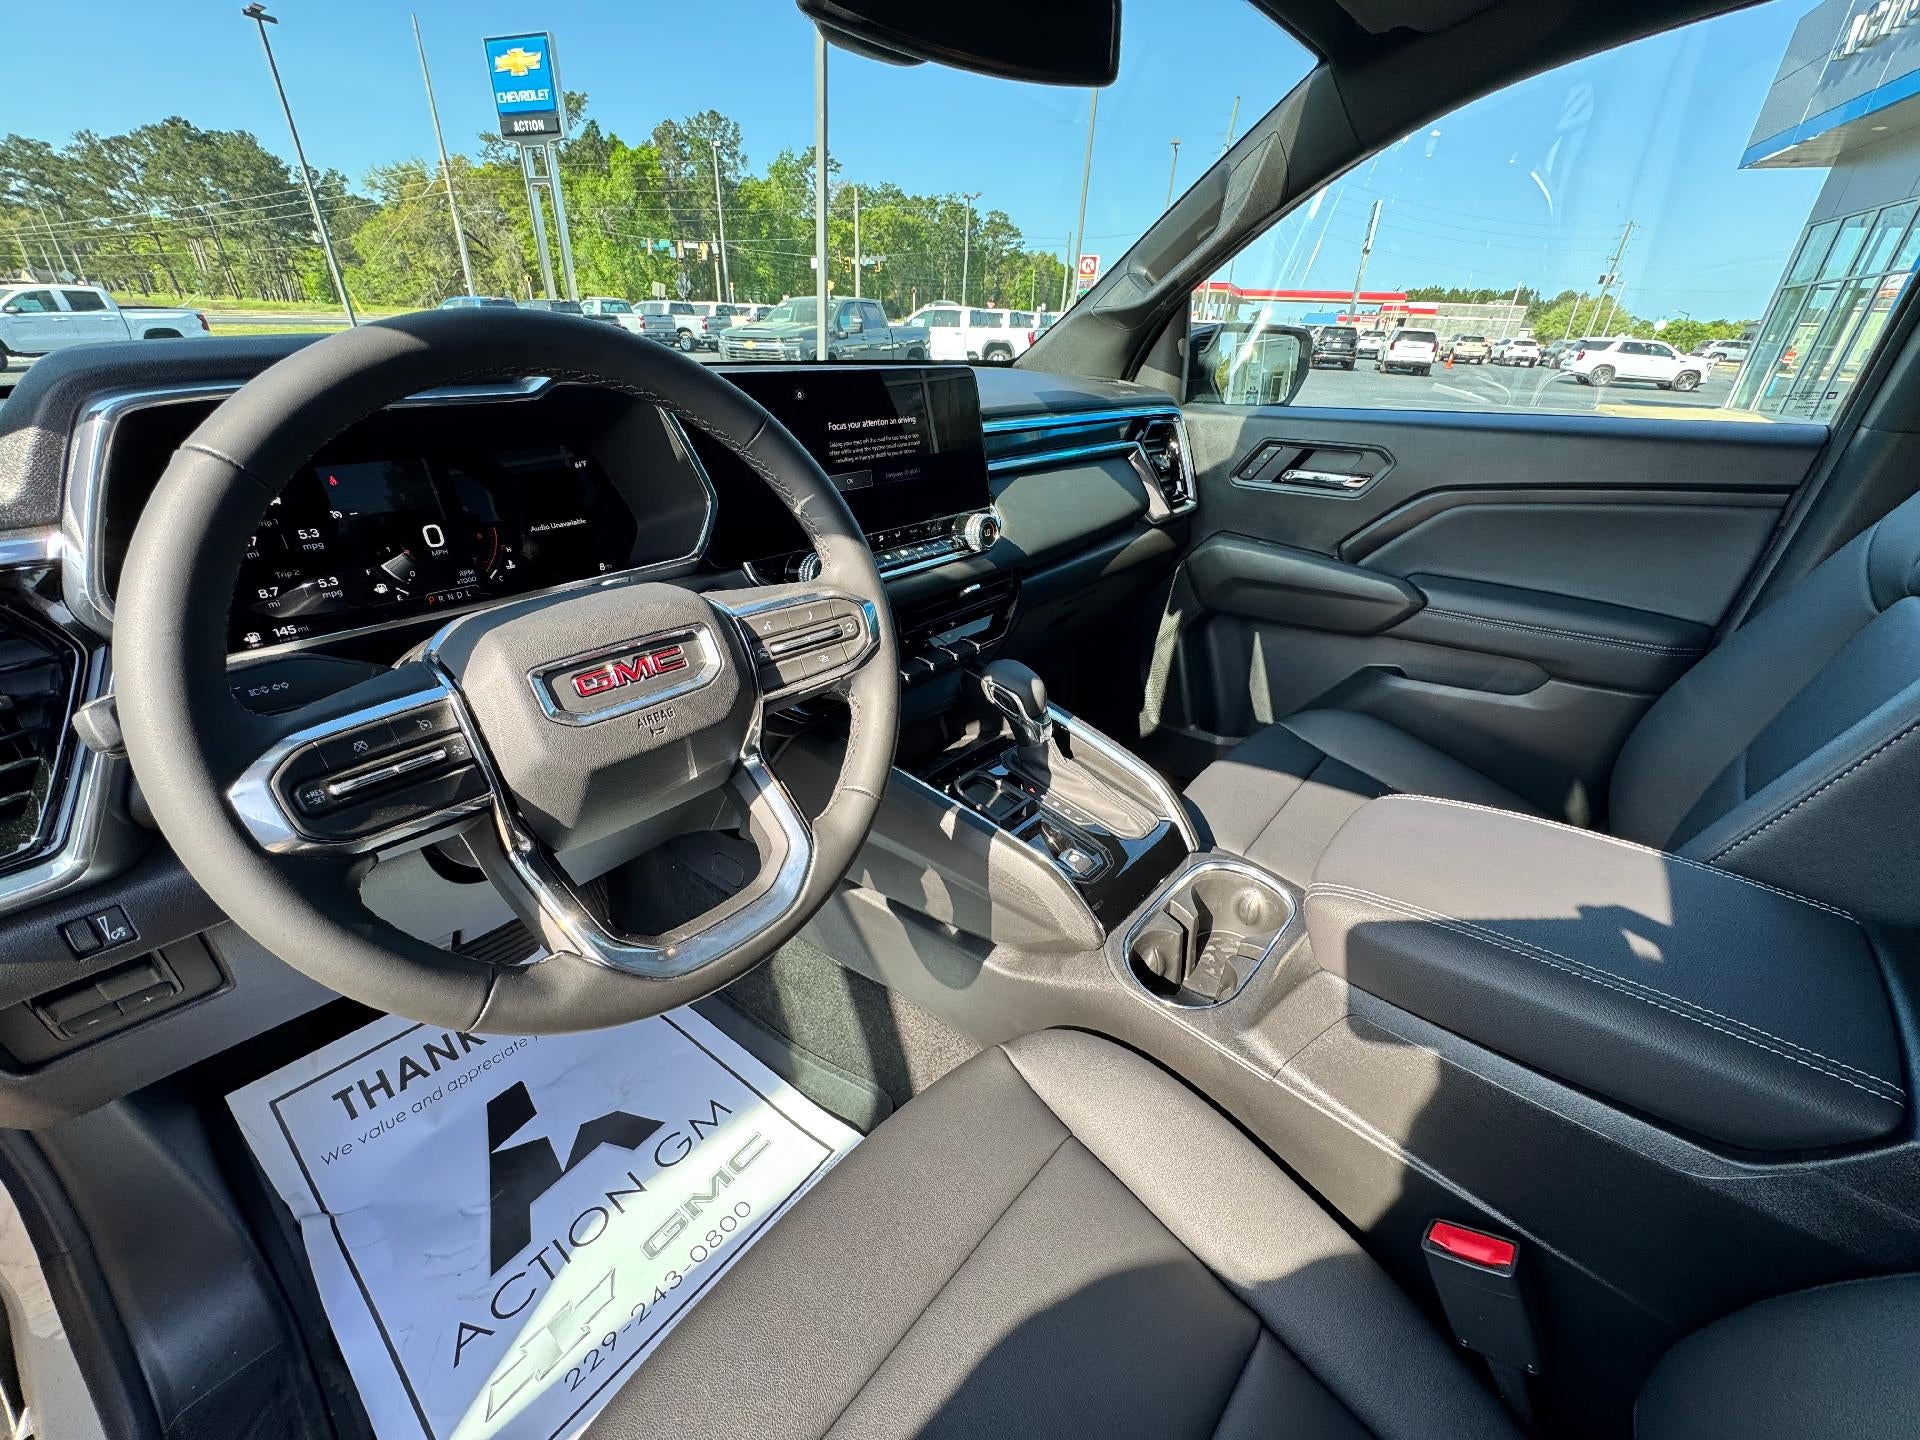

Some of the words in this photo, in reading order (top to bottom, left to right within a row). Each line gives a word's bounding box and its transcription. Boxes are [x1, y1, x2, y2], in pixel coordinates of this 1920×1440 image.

[497, 88, 549, 104] CHEVROLET
[513, 119, 545, 132] ACTION
[828, 421, 847, 431] Focus
[848, 422, 861, 431] your
[862, 418, 889, 428] attention
[897, 415, 917, 425] driving
[530, 523, 551, 533] Audio
[550, 517, 587, 529] Unavailable
[297, 528, 320, 540] 5.3
[422, 524, 446, 548] 0
[302, 541, 326, 552] mpg
[431, 549, 449, 557] MPH
[246, 549, 261, 560] mi
[275, 571, 293, 580] Trip
[293, 568, 301, 577] 2
[317, 576, 339, 589] 5.3
[257, 586, 279, 599] 8.7
[322, 588, 344, 600] mpg
[267, 600, 281, 609] mi
[272, 624, 297, 638] 145
[572, 644, 690, 698] GMC
[637, 708, 676, 730] AIRBAG
[331, 1031, 488, 1121] THANK
[320, 1143, 353, 1166] We
[358, 1112, 407, 1144] value
[411, 1087, 443, 1114] and
[447, 1036, 529, 1092] appreciate
[640, 1131, 772, 1261] GMC
[453, 1171, 648, 1368] ACTION
[654, 1099, 733, 1168] GM
[564, 1201, 751, 1392] 229-243-0800
